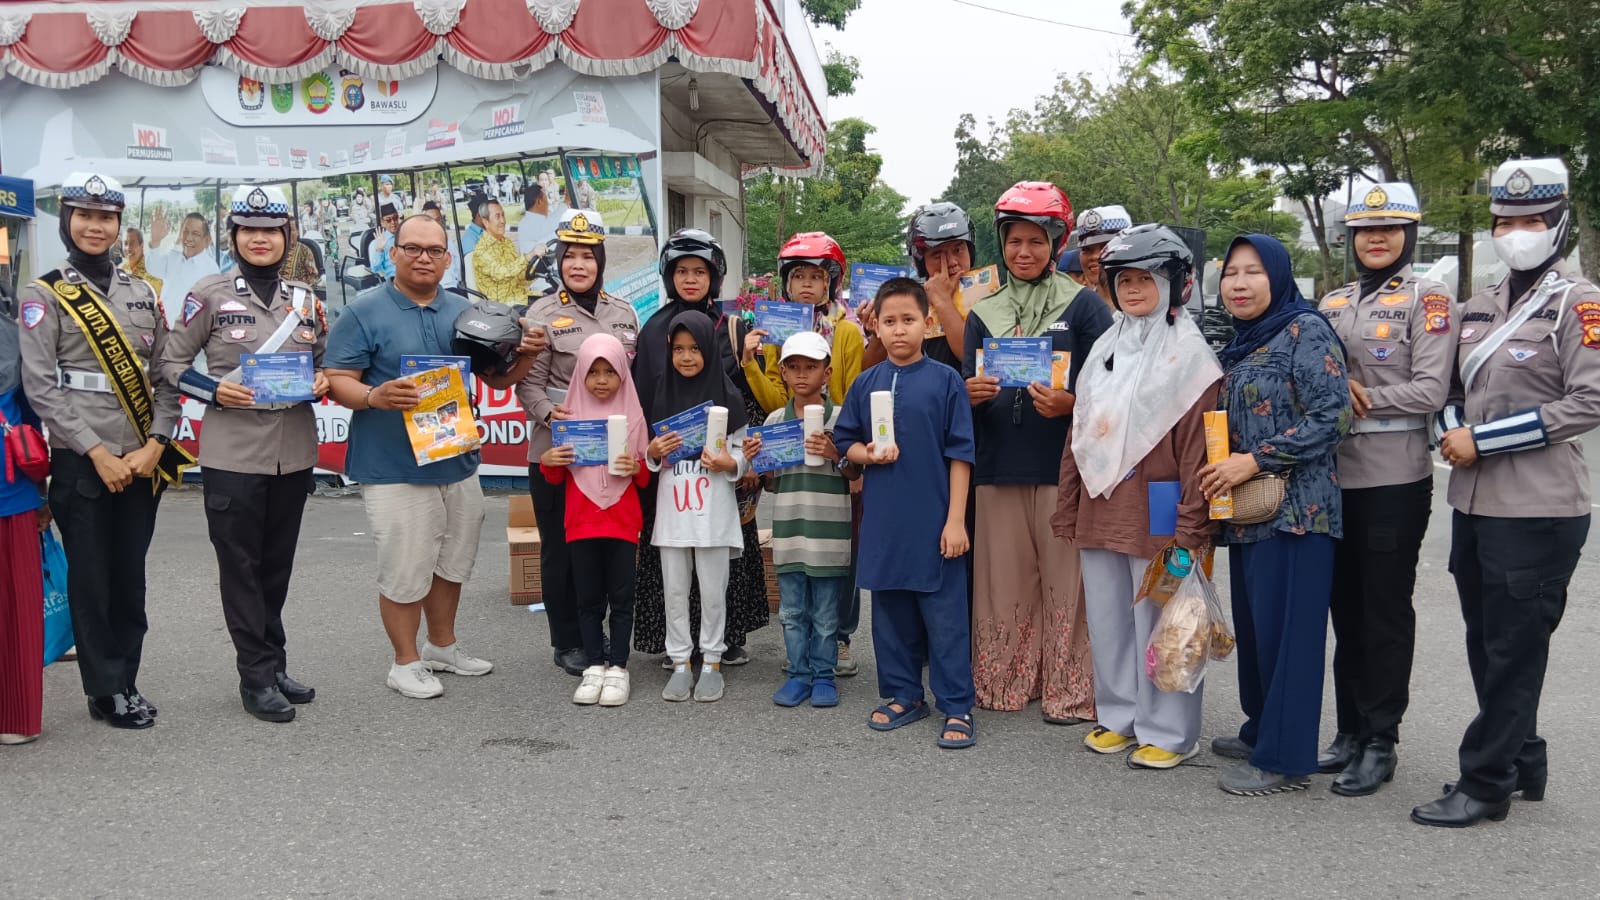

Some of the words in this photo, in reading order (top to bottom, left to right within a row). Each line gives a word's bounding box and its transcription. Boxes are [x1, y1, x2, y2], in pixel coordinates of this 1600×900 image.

[370, 101, 407, 110] BAWASLU
[494, 106, 514, 127] NO!
[137, 128, 160, 148] NO!
[484, 123, 525, 139] PERPECAHAN
[127, 147, 172, 160] PERMUSUHAN
[218, 314, 256, 326] PUTRI
[1369, 310, 1406, 319] POLRI
[77, 302, 110, 336] DUTA
[101, 335, 150, 415] PENERIMAAN
